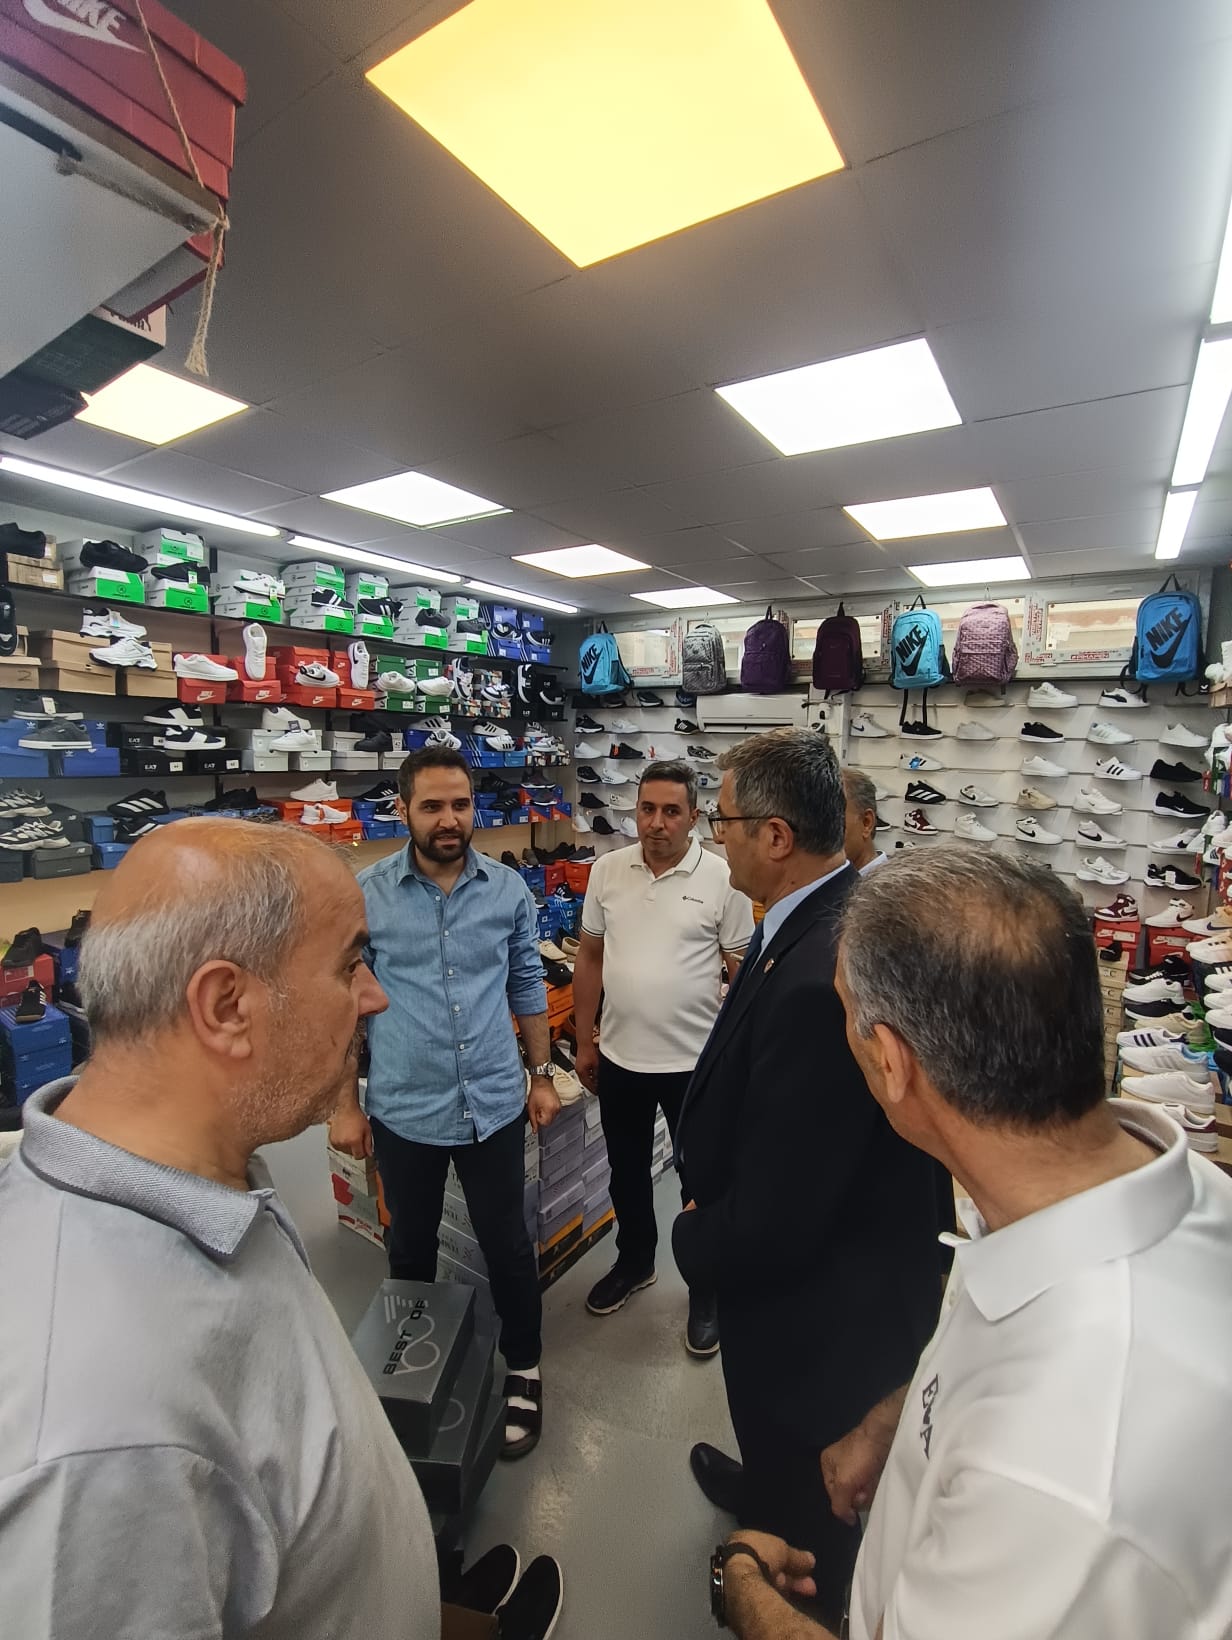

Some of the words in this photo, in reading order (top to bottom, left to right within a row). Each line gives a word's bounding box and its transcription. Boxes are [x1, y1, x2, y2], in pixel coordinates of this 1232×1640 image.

[895, 624, 925, 663] NIKE
[1145, 607, 1184, 651] NIKE
[581, 643, 598, 673] NIKE
[383, 1330, 412, 1375] BEST
[410, 1300, 426, 1320] OF
